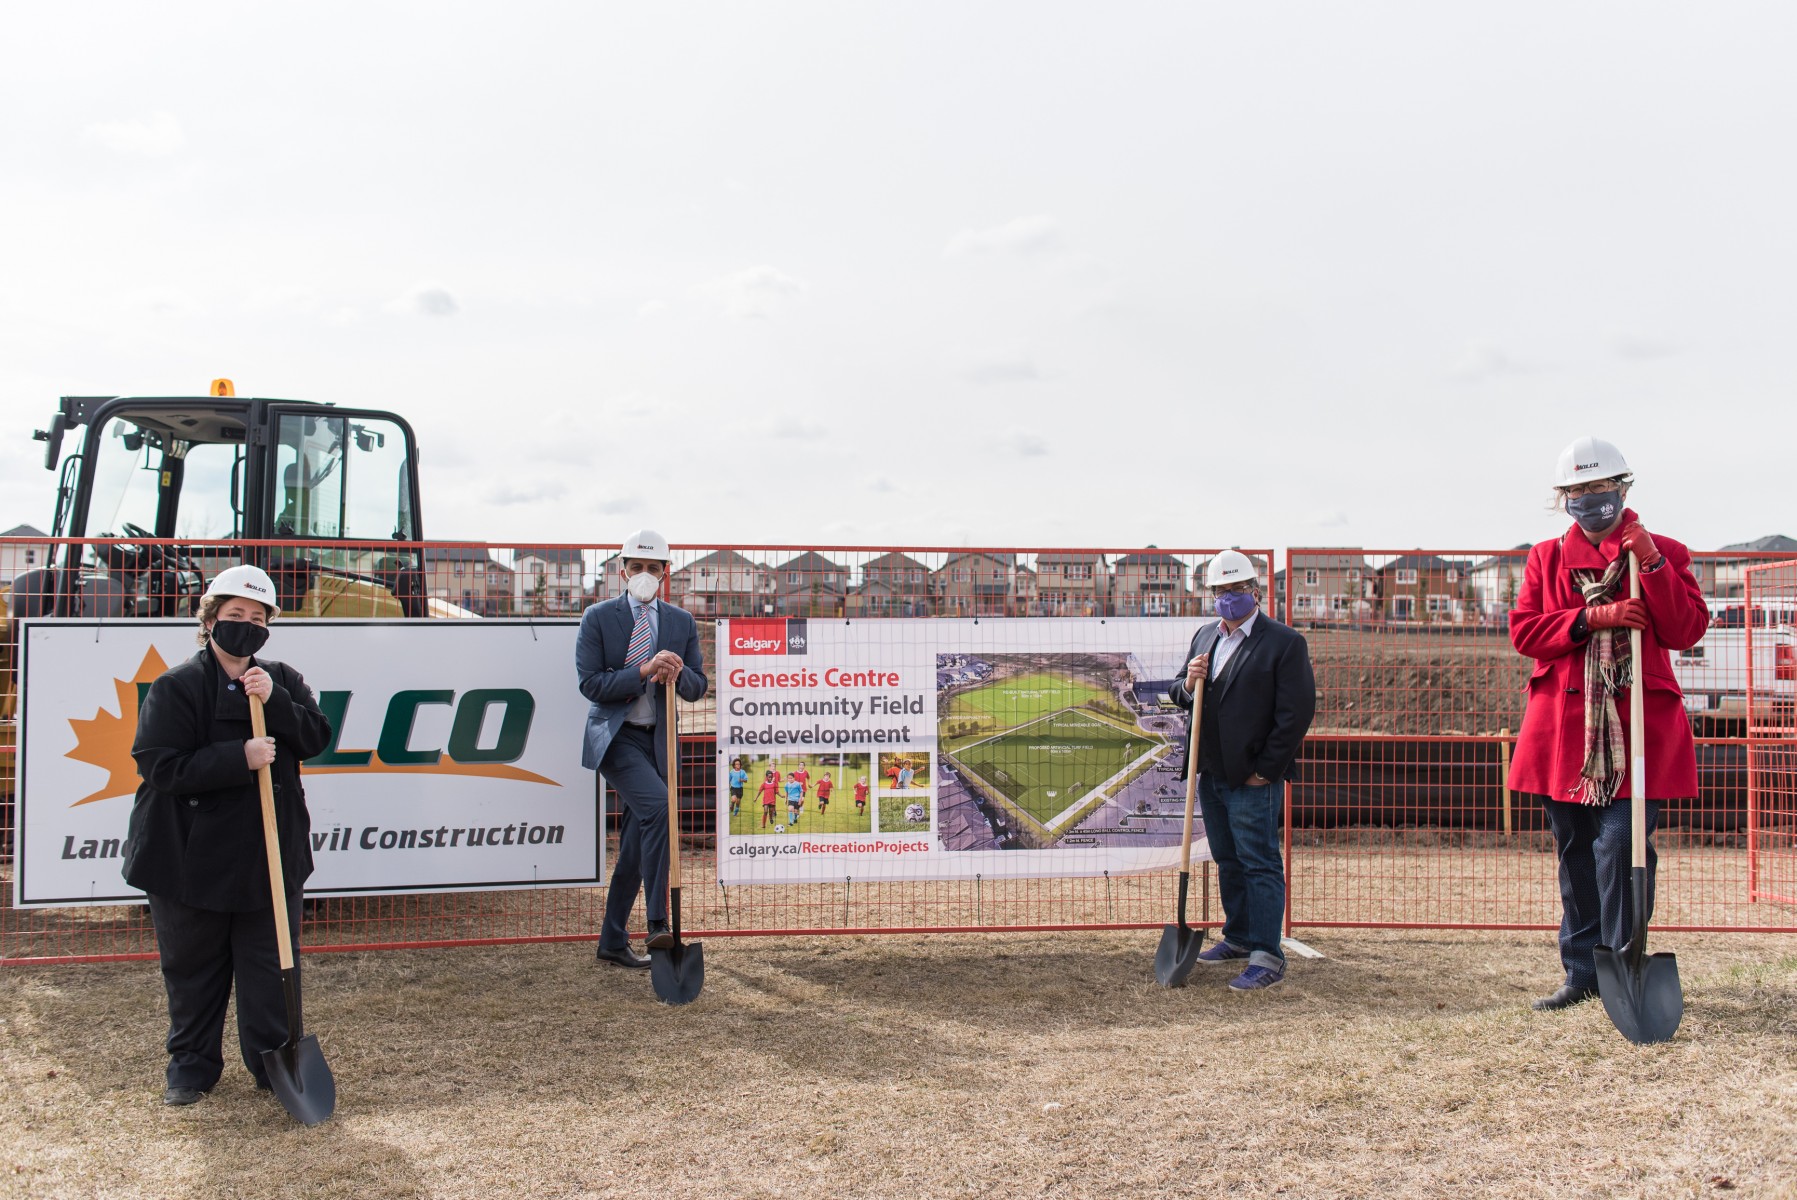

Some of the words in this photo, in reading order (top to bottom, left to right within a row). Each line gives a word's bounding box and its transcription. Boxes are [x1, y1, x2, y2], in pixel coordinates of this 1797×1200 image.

[734, 637, 781, 651] Calgary
[1675, 660, 1710, 668] GMC
[729, 668, 818, 688] Genesis
[824, 667, 900, 687] Centre
[729, 696, 863, 720] Community
[870, 695, 924, 714] Field
[730, 724, 910, 748] Redevelopment
[359, 822, 565, 850] Construction
[729, 840, 929, 858] calgary.ca/RecreationProjects
